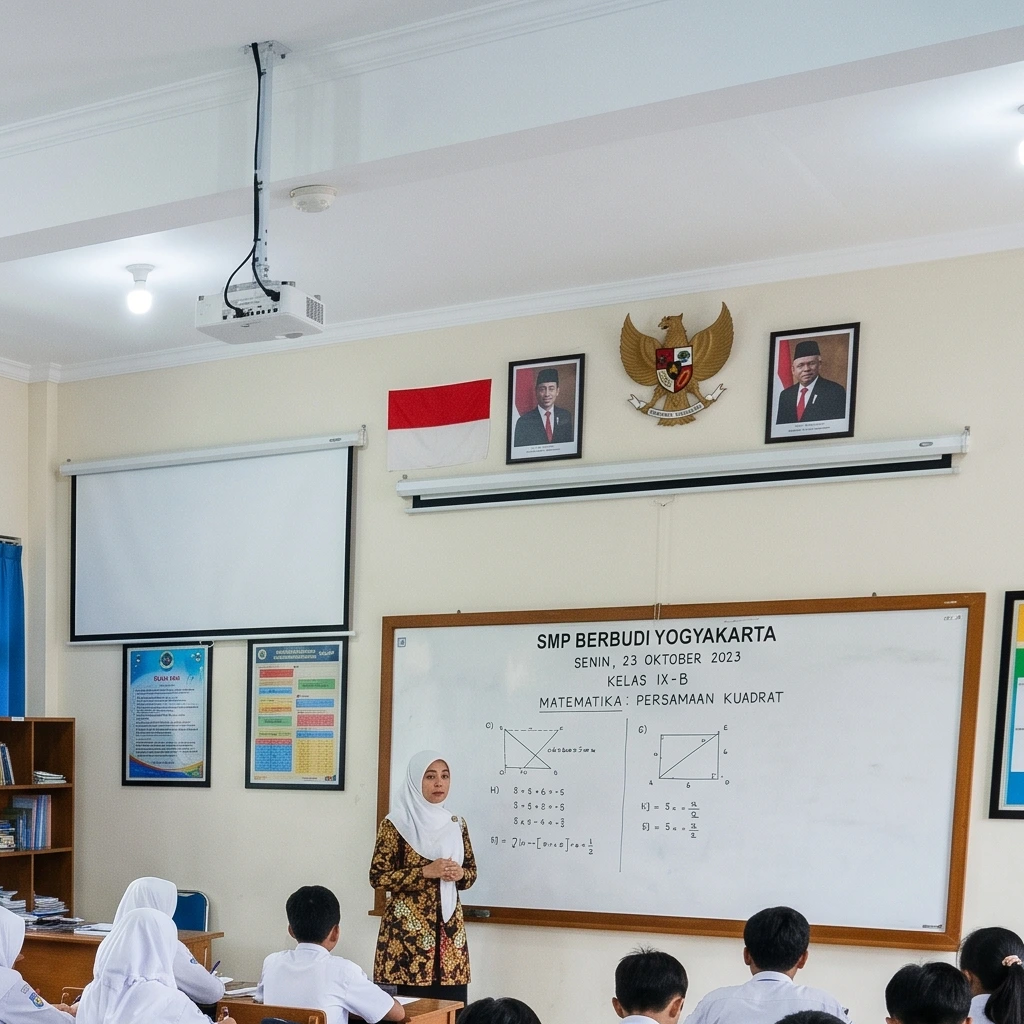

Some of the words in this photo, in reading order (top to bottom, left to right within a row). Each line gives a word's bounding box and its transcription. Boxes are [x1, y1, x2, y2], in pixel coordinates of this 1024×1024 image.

[537, 633, 571, 649] SMP
[575, 630, 650, 648] BERBUDI
[655, 626, 777, 646] YOGYAKARTA
[574, 656, 616, 669] SENIN,
[623, 655, 638, 667] 23
[644, 653, 702, 666] OKTOBER
[711, 651, 741, 664] 2023
[607, 674, 647, 687] KELAS
[636, 693, 715, 706] PERSAMAAN
[724, 691, 784, 704] KUADRAT
